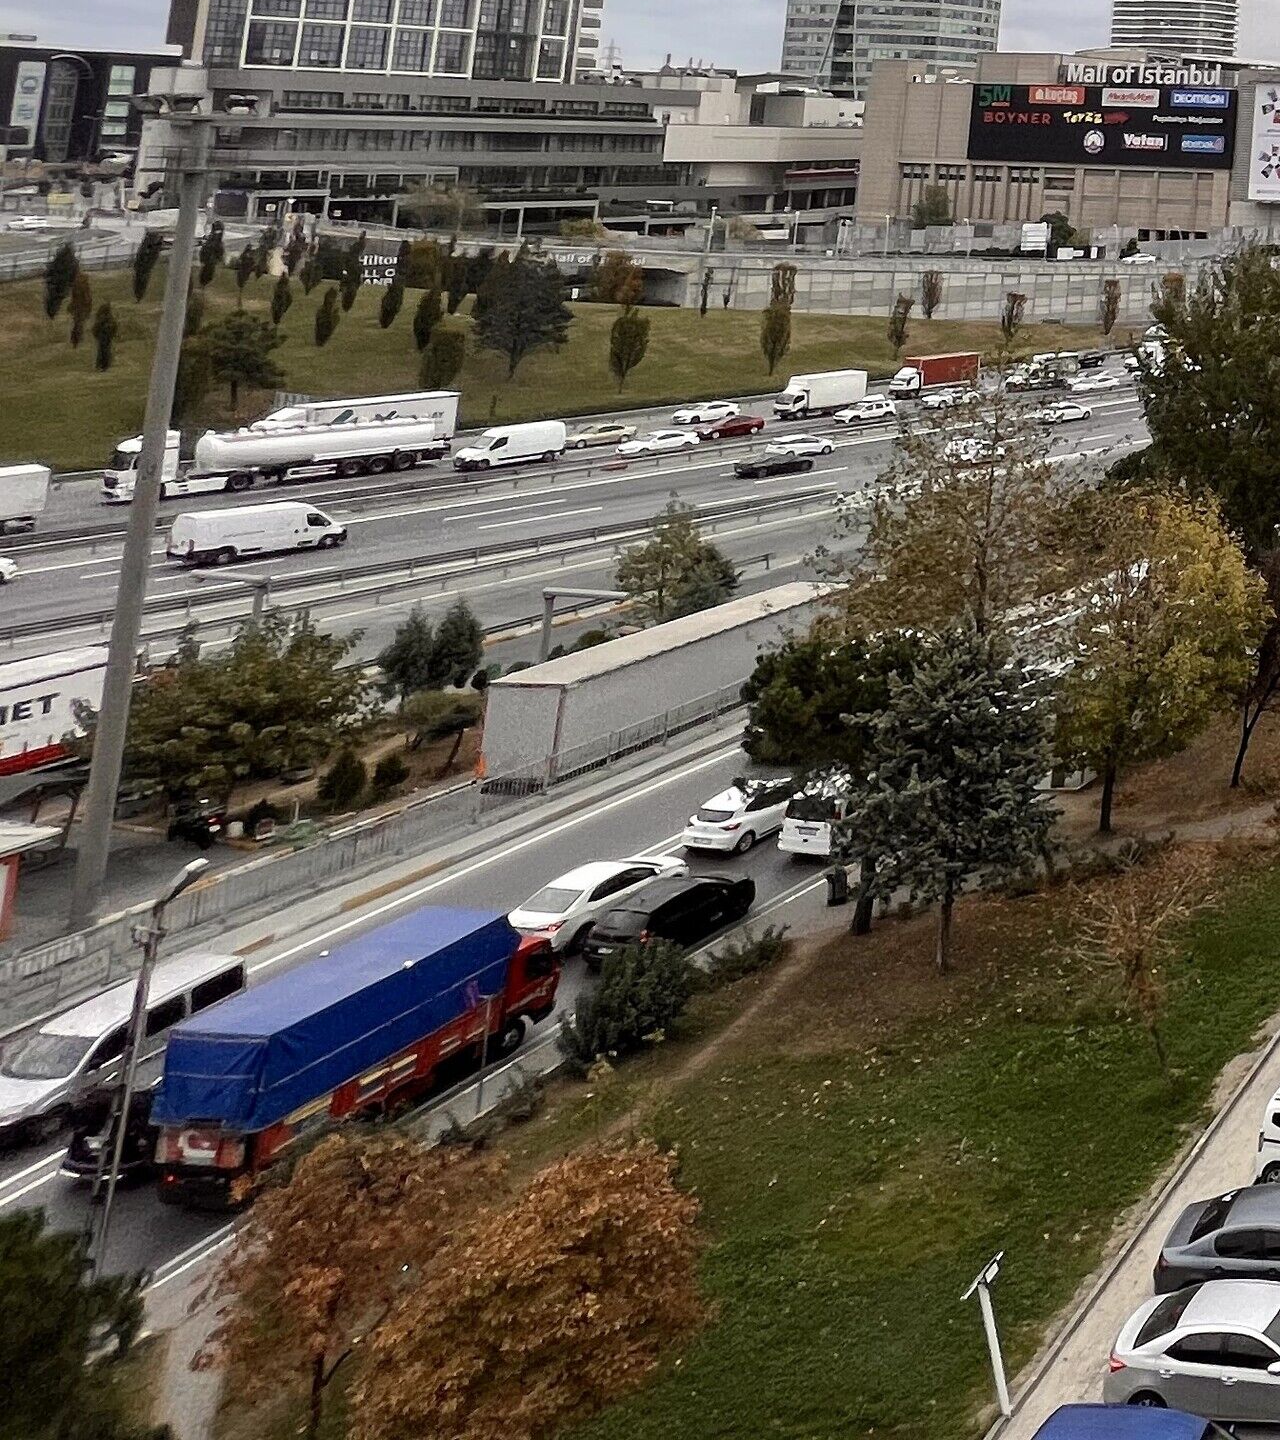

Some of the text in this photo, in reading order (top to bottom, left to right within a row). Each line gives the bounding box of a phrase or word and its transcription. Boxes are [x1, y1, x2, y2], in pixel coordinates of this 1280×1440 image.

[1066, 63, 1108, 83] Mall
[1112, 64, 1135, 84] of
[983, 111, 1052, 125] BOYNER
[1123, 133, 1164, 147] Vatan
[0, 691, 61, 726] ET
